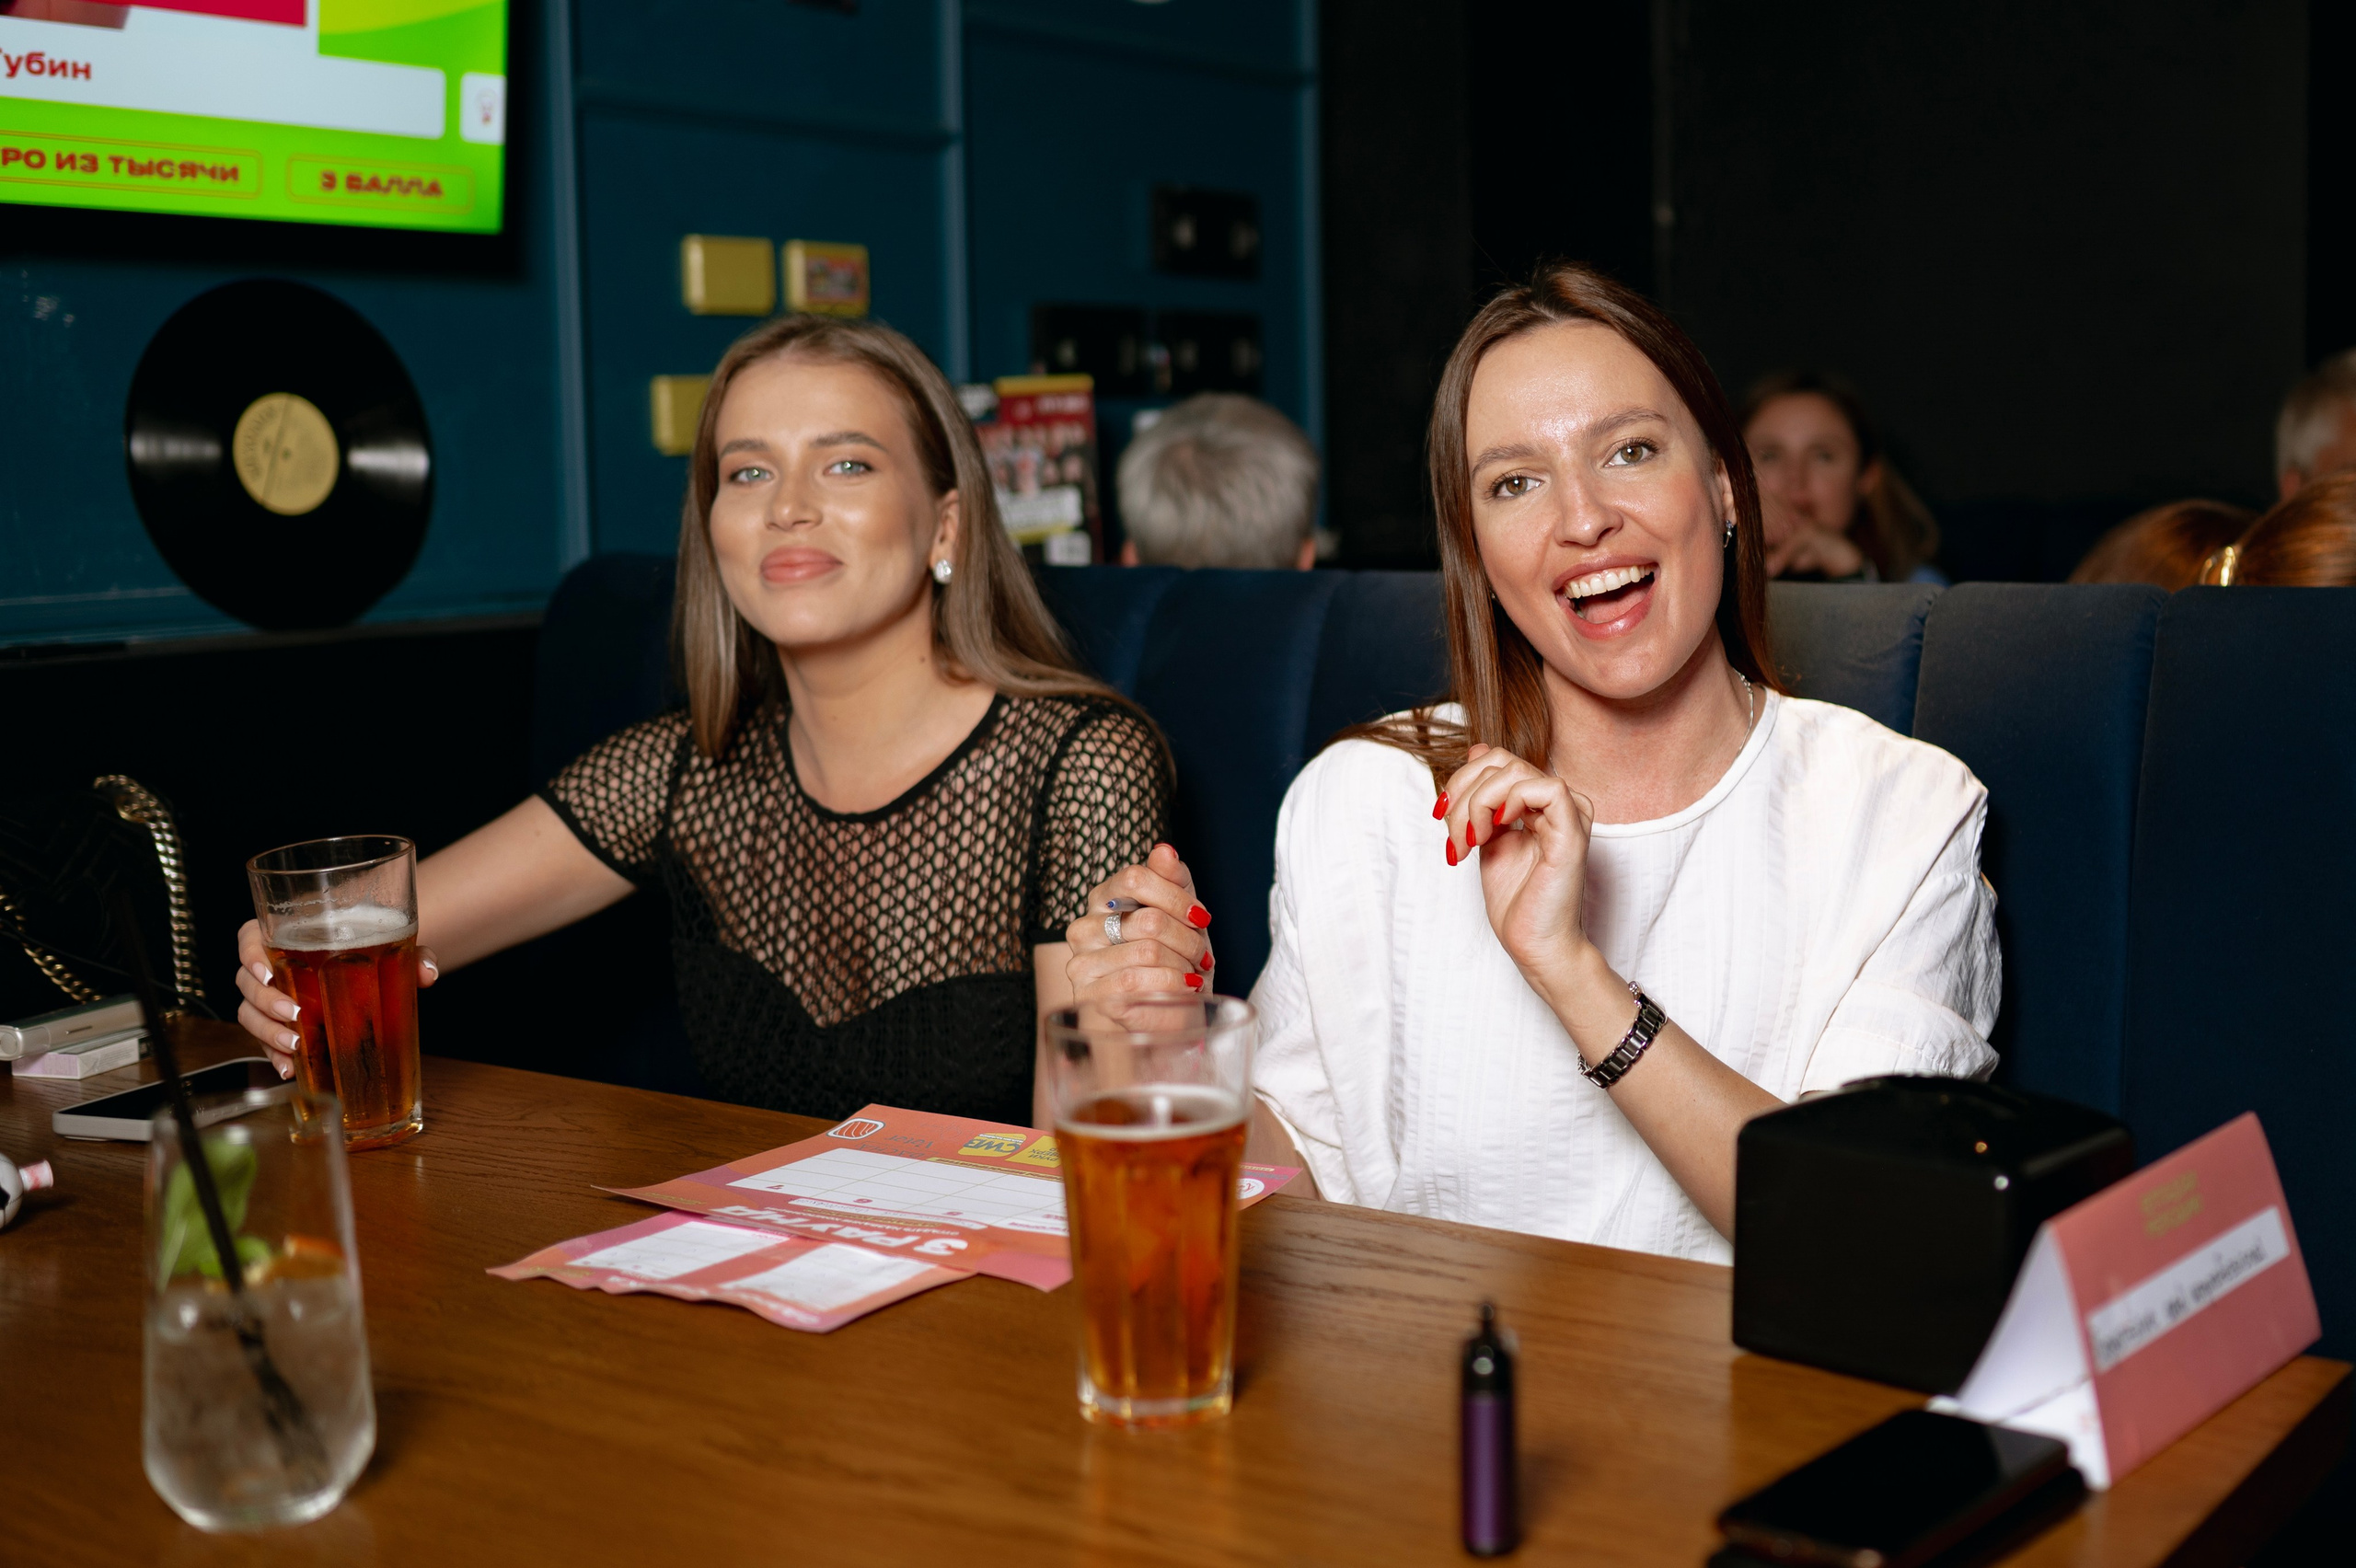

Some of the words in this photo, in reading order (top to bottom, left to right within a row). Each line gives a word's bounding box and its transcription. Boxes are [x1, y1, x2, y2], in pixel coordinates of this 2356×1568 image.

[0, 48, 91, 80] убин
[55, 152, 98, 174] ИЗ
[109, 154, 239, 182] ТЫСЯЧИ
[963, 1138, 1021, 1153] CWB
[711, 1205, 921, 1247] РАУНД
[913, 1239, 968, 1256] 3
